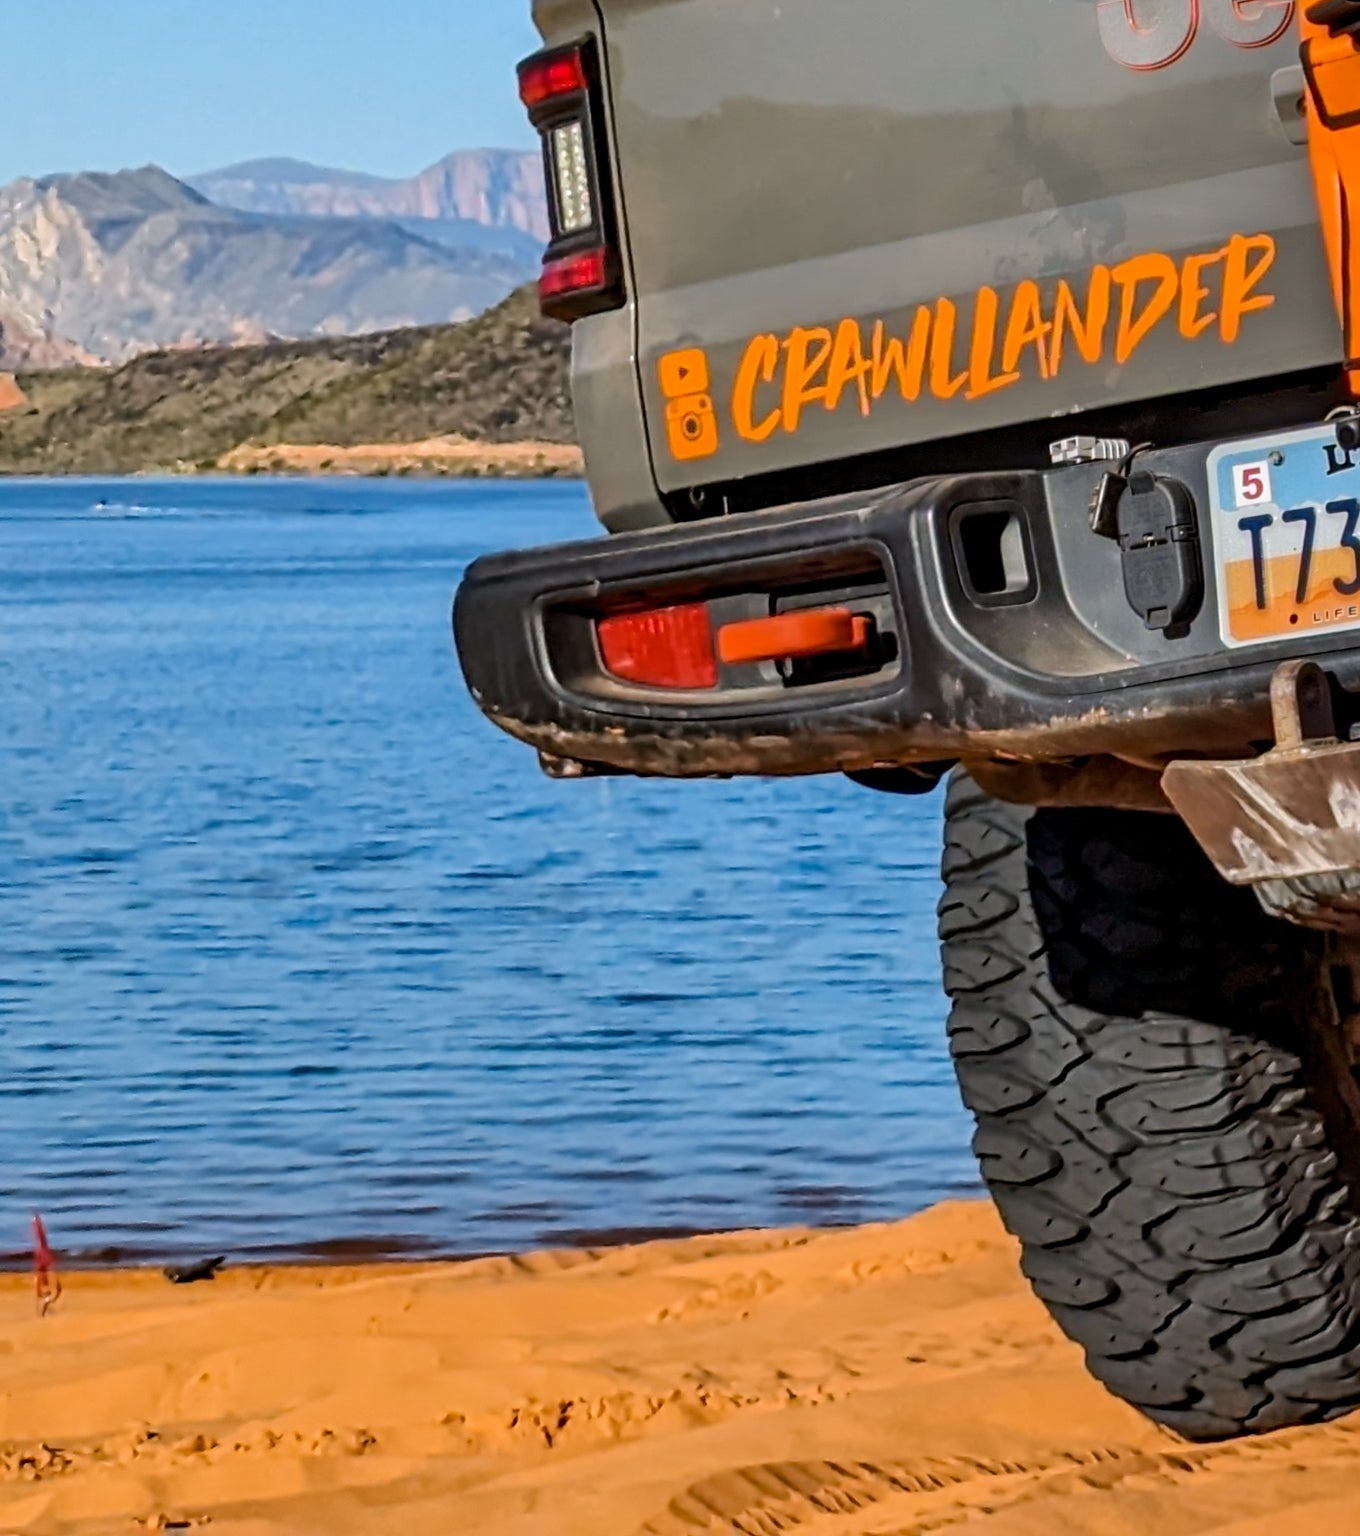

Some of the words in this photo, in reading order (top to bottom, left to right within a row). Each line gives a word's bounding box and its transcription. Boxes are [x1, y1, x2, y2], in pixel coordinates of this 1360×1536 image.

[731, 231, 1276, 443] CRAWLLANDER
[1240, 466, 1265, 500] 5
[1311, 604, 1359, 624] LIFE
